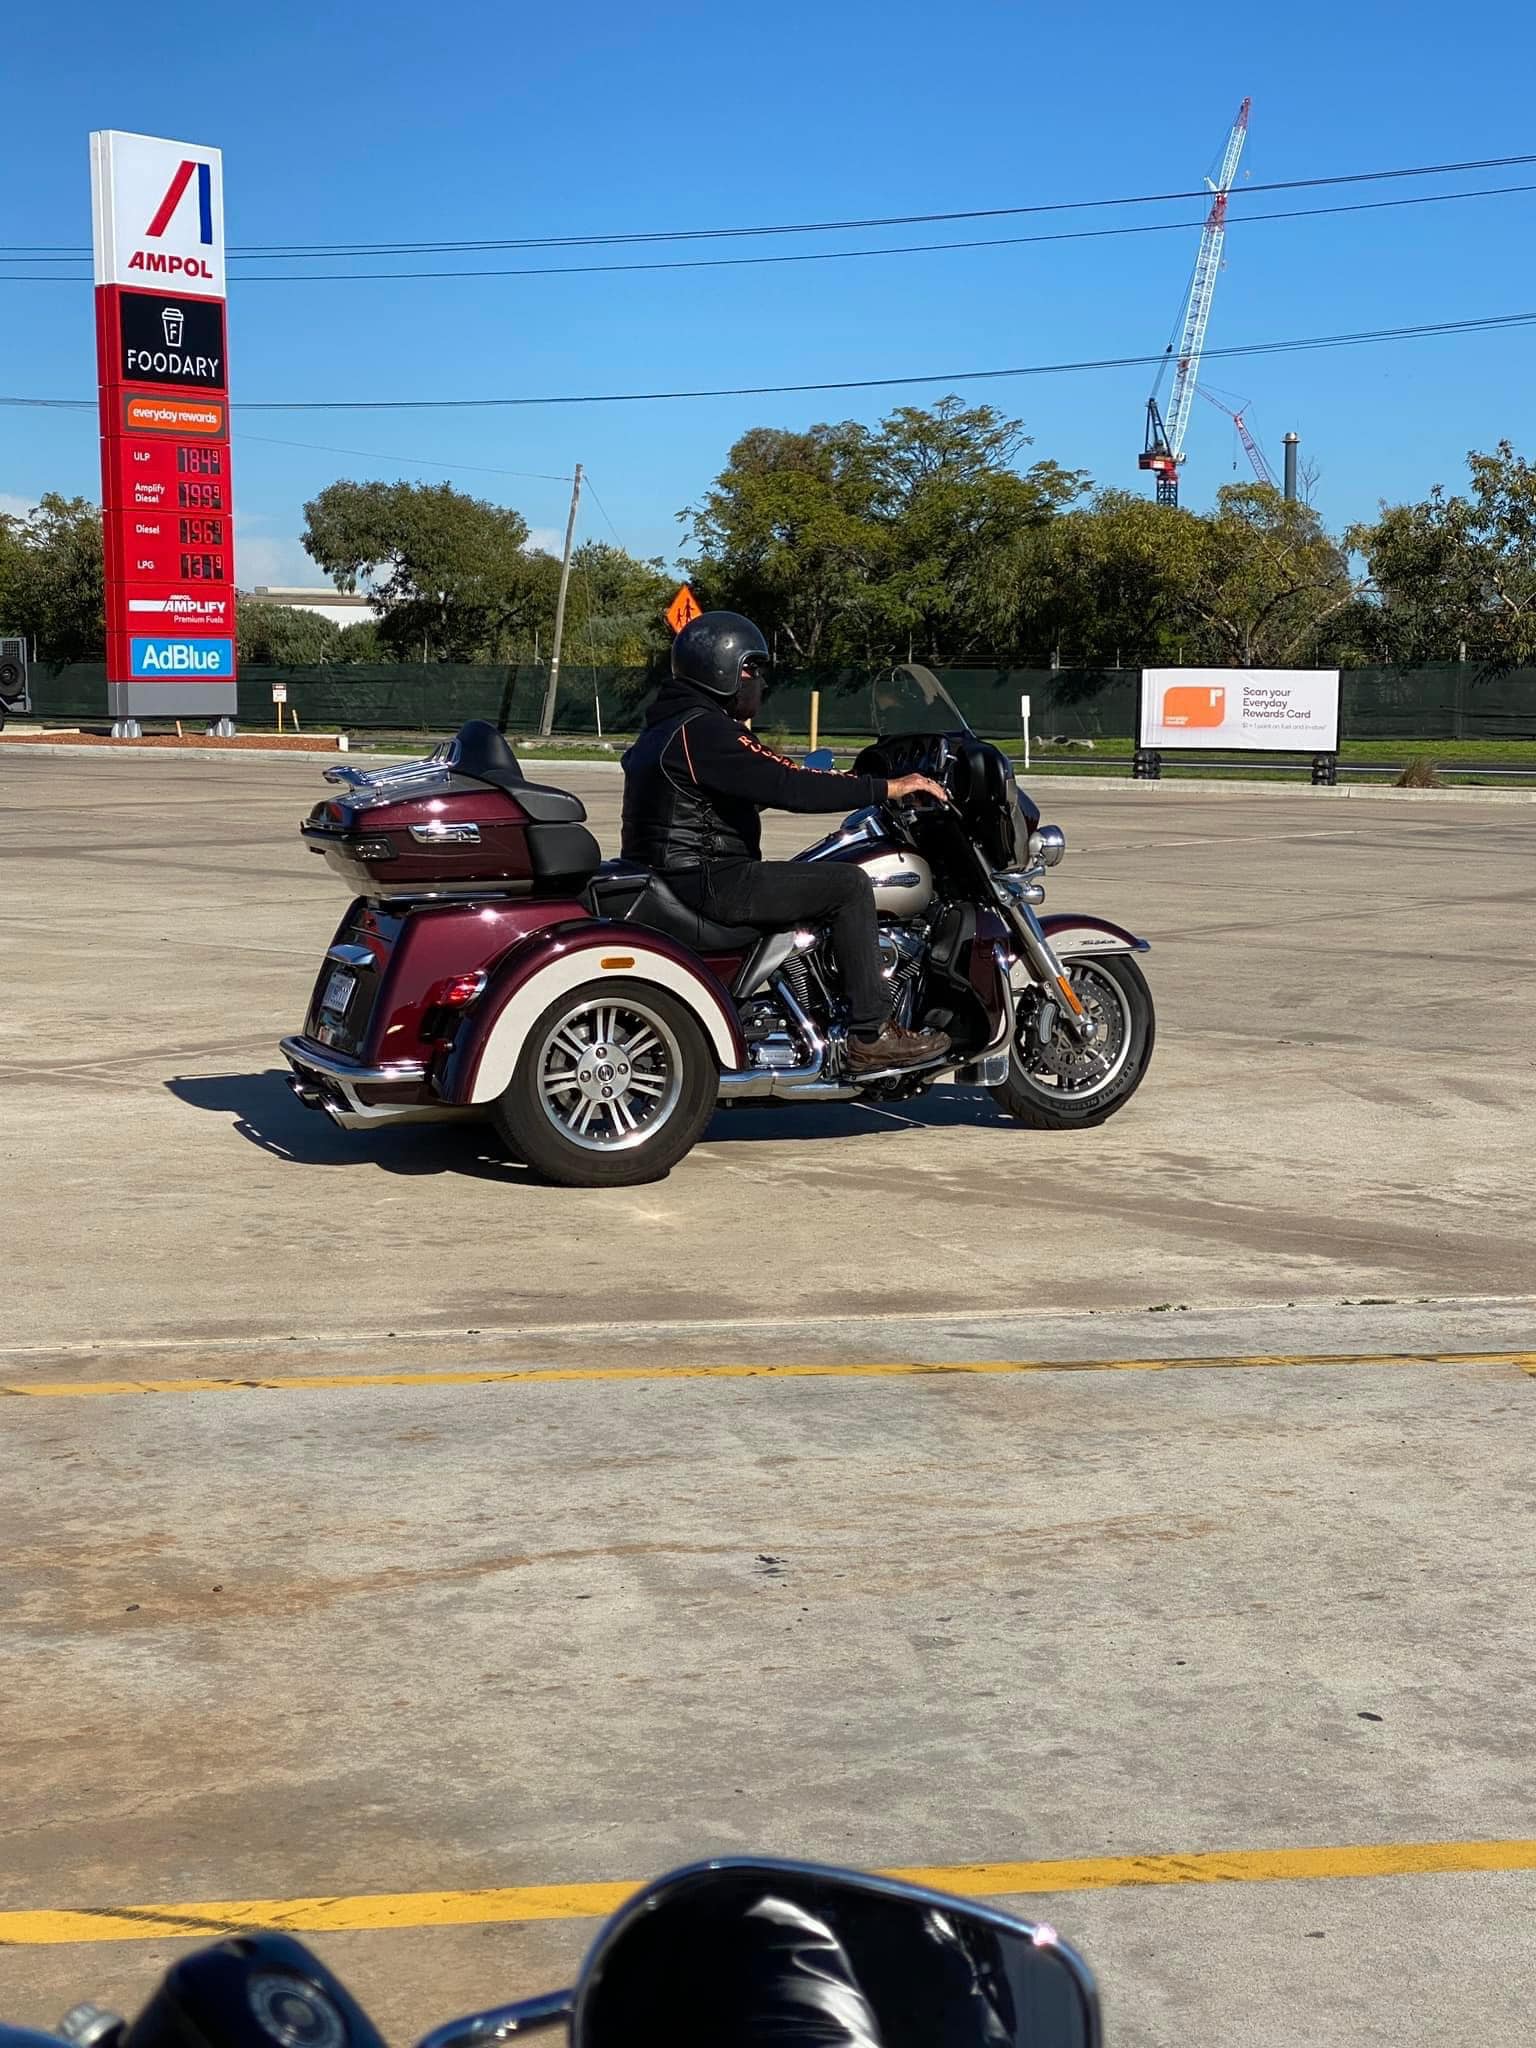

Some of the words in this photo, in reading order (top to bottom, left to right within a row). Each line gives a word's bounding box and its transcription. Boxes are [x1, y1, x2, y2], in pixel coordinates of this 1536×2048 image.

[128, 251, 213, 278] AMPOL
[127, 349, 219, 377] FOODARY
[133, 408, 177, 423] everyday
[178, 411, 217, 424] rewards
[134, 452, 151, 462] ULP
[135, 483, 165, 494] Amplify
[135, 494, 160, 503] Diesel
[136, 524, 160, 535] Diesel
[137, 560, 155, 570] LPG
[165, 601, 226, 613] AMPLIFY
[173, 614, 205, 624] Premium
[205, 615, 224, 624] Fuels
[142, 644, 220, 670] AdBlue
[1243, 687, 1268, 696] Scan
[1269, 689, 1292, 698] your
[1243, 698, 1288, 710] Everyday
[1243, 709, 1285, 718] Rewards
[1286, 709, 1311, 719] Card
